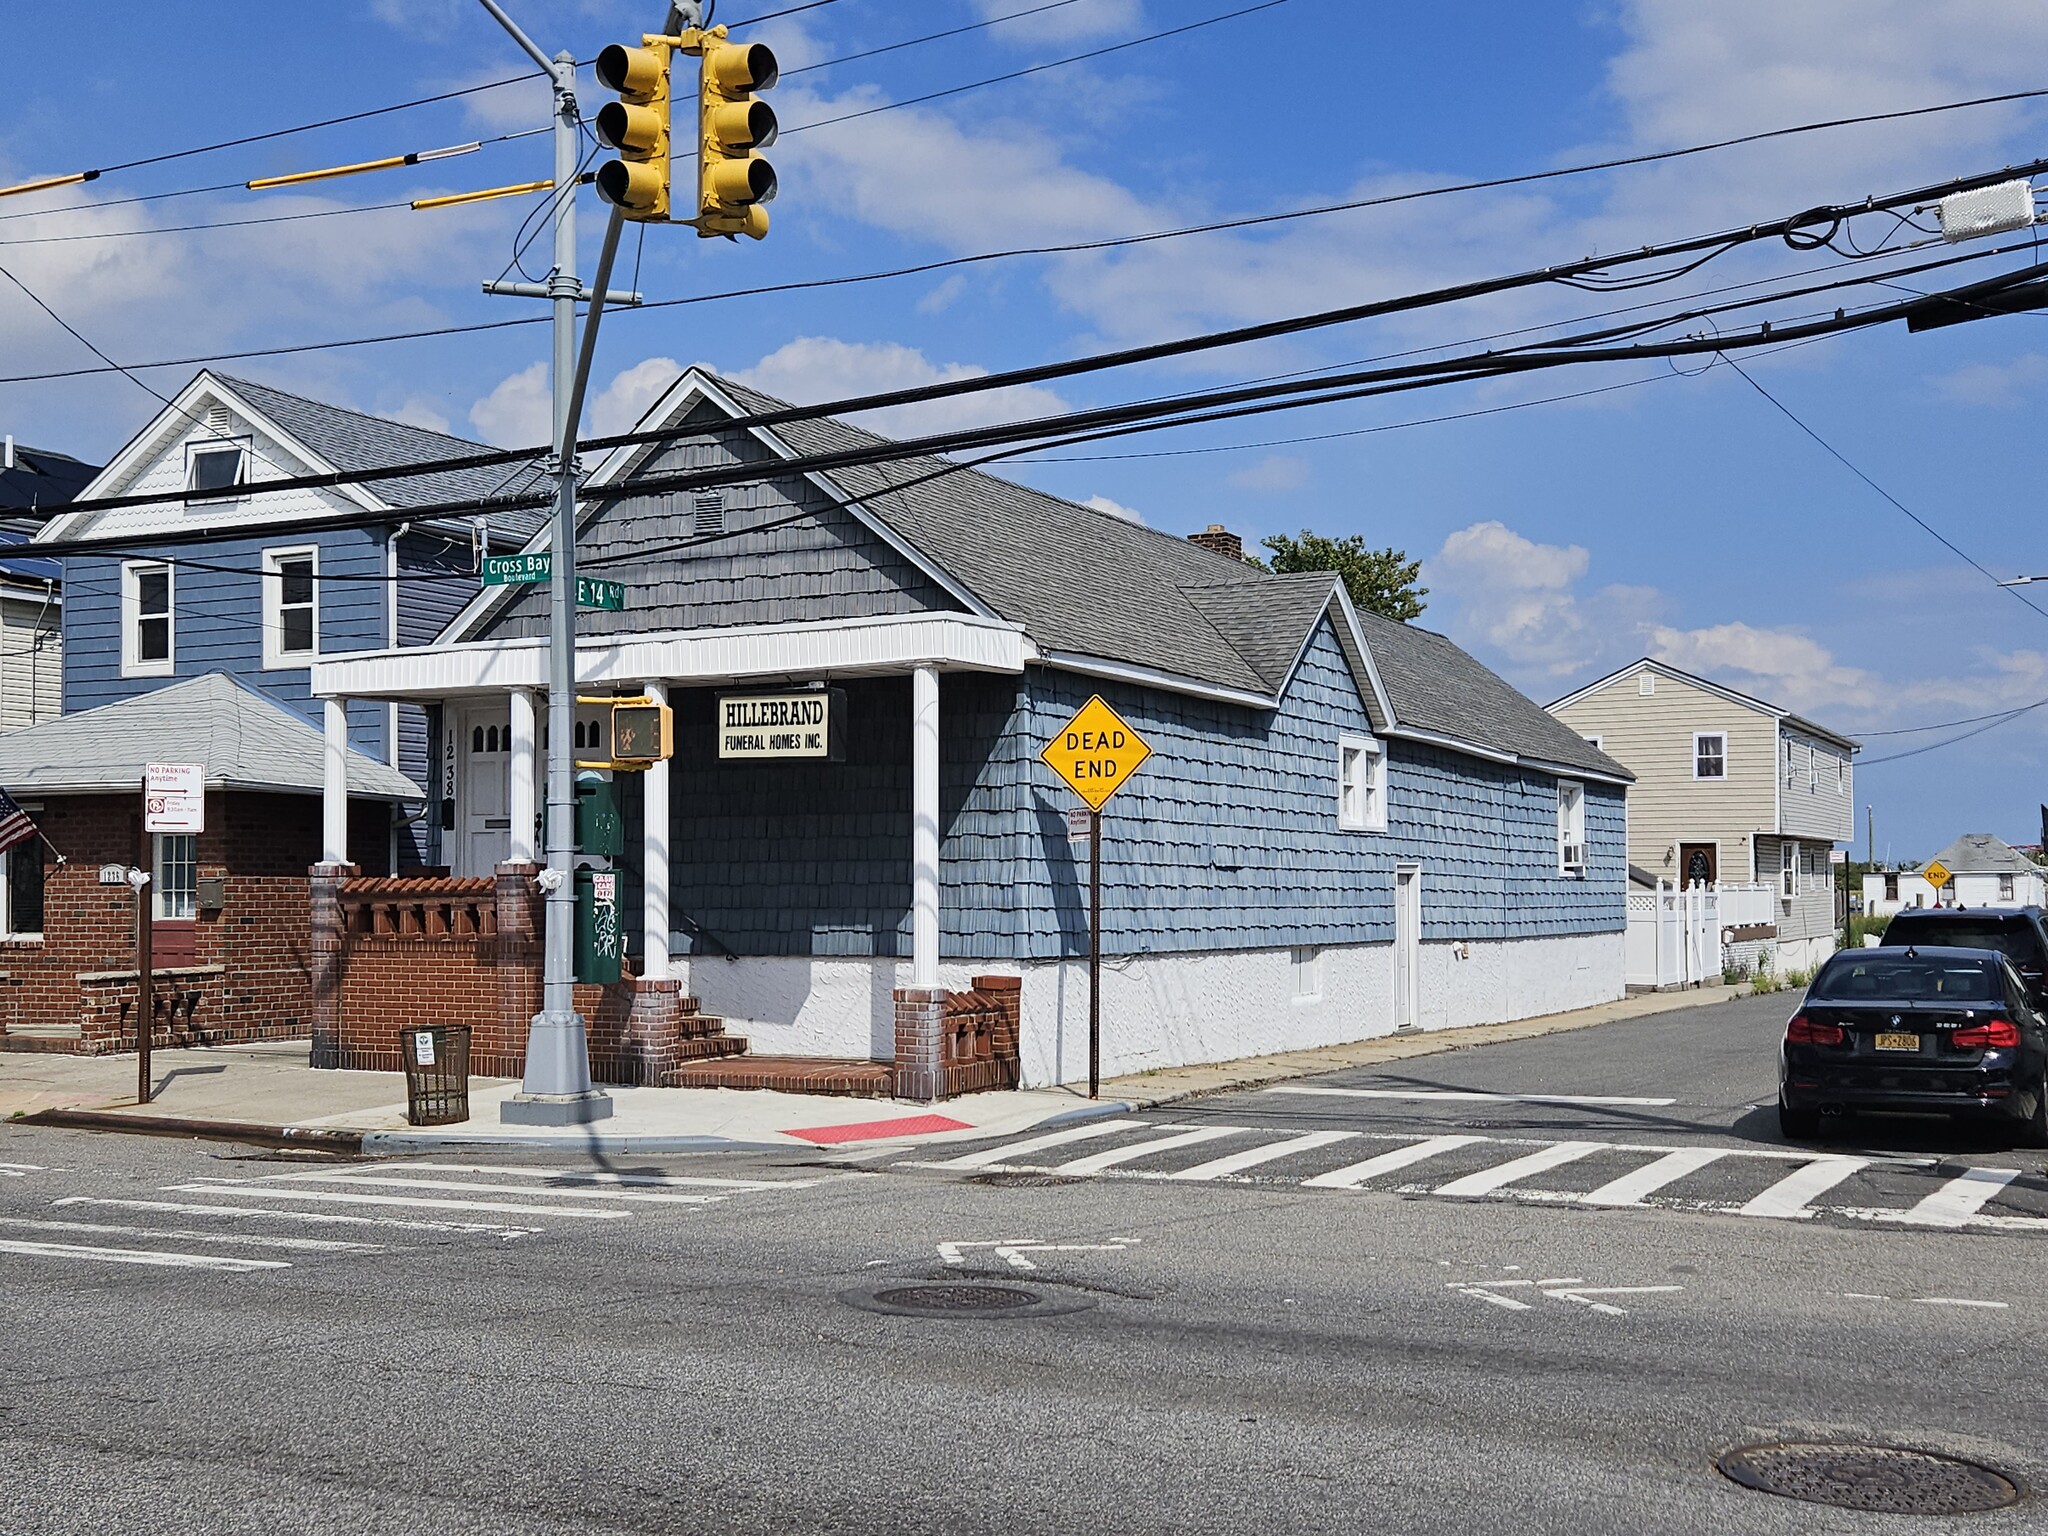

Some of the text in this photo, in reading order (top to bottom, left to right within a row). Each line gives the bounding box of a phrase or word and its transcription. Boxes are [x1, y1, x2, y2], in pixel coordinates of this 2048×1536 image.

[489, 556, 551, 574] Cross Bay
[503, 572, 536, 582] Boulevard
[578, 581, 619, 604] E 14 Rd
[725, 700, 824, 727] HILLEBRAND
[725, 732, 822, 751] FUNERAL HOMES INC.
[1066, 730, 1125, 750] DEAD
[162, 767, 191, 775] PARKING
[446, 729, 454, 796] 1238
[1074, 759, 1117, 779] END
[150, 775, 178, 783] Anytime
[1070, 818, 1087, 826] Anytime
[1928, 871, 1946, 879] END
